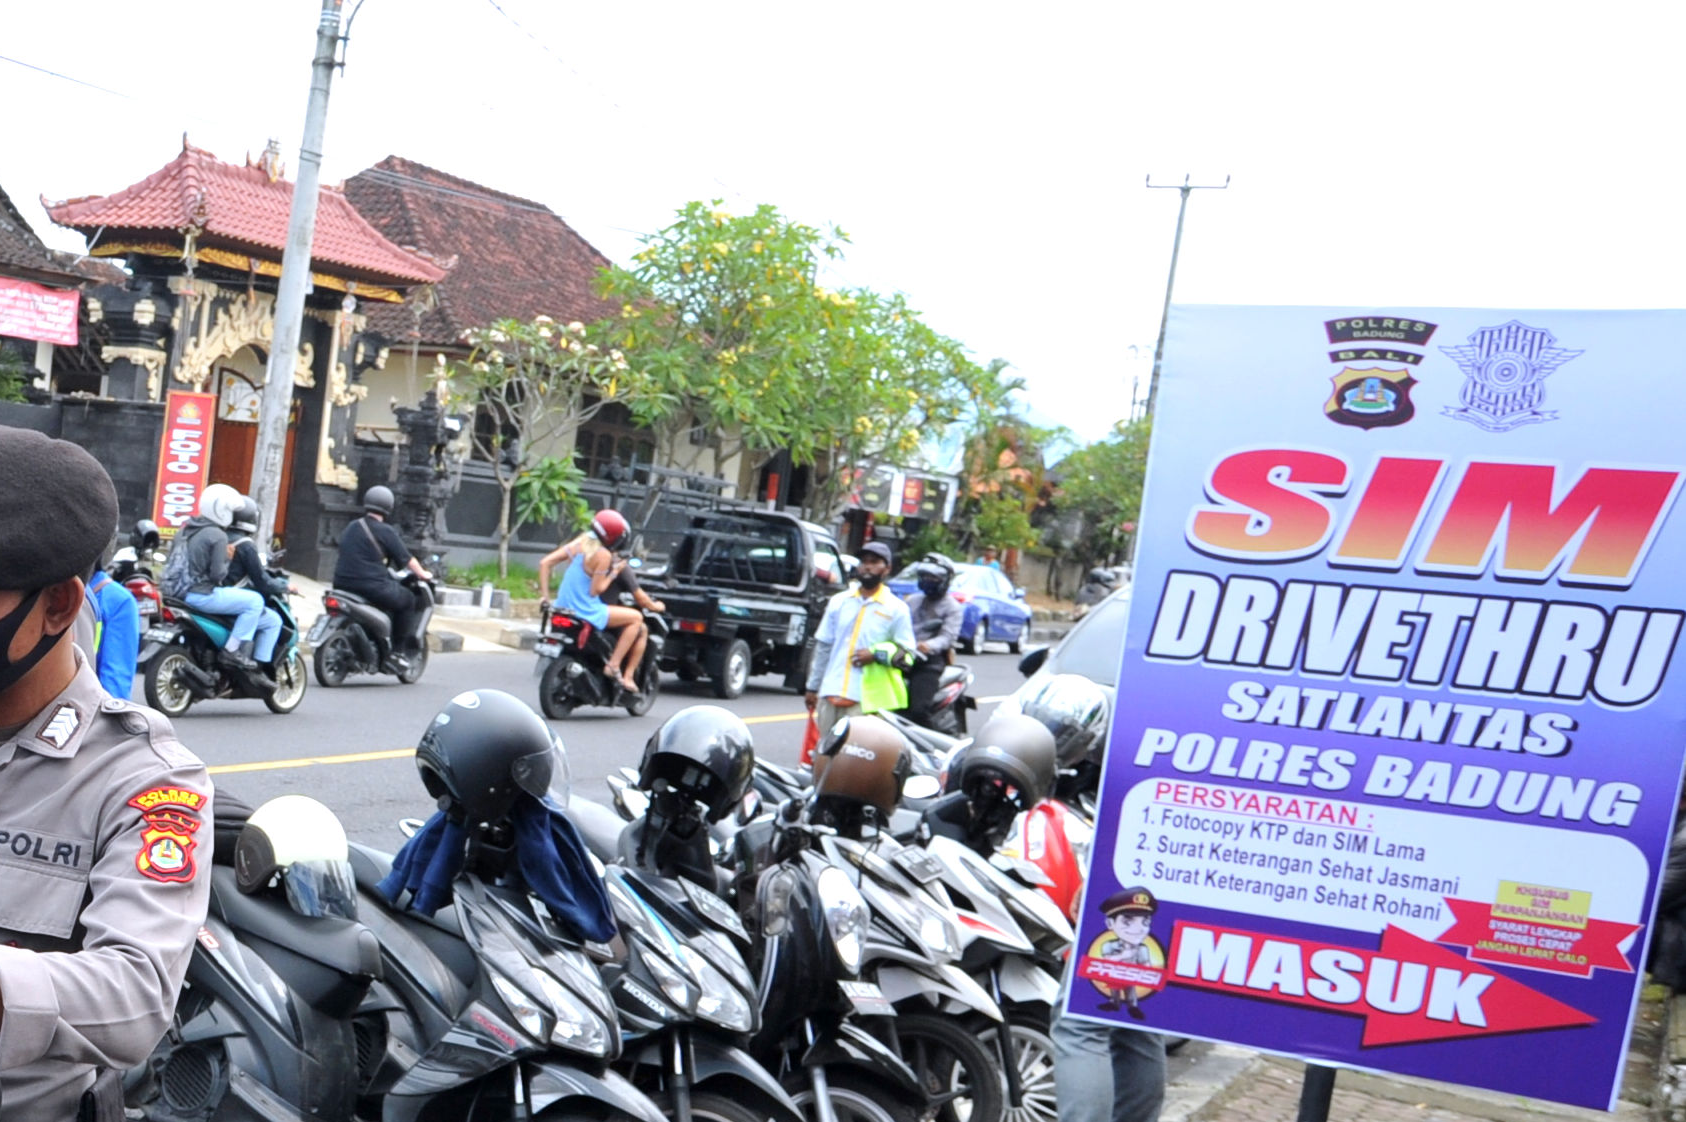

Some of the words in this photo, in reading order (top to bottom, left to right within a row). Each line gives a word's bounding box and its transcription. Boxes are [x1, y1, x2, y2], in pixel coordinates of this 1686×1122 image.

[1335, 318, 1427, 332] POLRES
[1352, 330, 1406, 340] BADUNG
[1338, 350, 1415, 363] BALI
[166, 428, 203, 474] FOTO
[162, 482, 195, 526] COPY
[1187, 446, 1684, 586] SIM
[1145, 569, 1685, 706] DRIVETHRU
[1222, 680, 1576, 757] SATLANTAS
[1134, 728, 1355, 790] POLRES
[1363, 754, 1642, 827] BADUNG
[1155, 781, 1358, 826] PERSYARATAN
[1142, 805, 1155, 825] 1.
[1161, 808, 1245, 841] Fotocopy
[1250, 820, 1289, 842] KTP
[1293, 827, 1327, 848] dan
[1333, 831, 1368, 854] SIM
[1374, 837, 1426, 862] Lama
[1136, 832, 1151, 852] 2.
[1156, 835, 1204, 859] Surat
[1209, 842, 1313, 876] Keterangan
[1319, 858, 1373, 884] Sehat
[1377, 867, 1461, 896] Jasmani
[1132, 858, 1147, 878] 3.
[1152, 862, 1200, 886] Surat
[1204, 868, 1308, 902] Keterangan
[1314, 885, 1368, 911] Sehat
[1372, 893, 1442, 922] Rohani
[1476, 940, 1519, 955] JANGAN
[1519, 945, 1556, 960] LEWAT
[1556, 951, 1588, 966] CALO
[1489, 919, 1530, 934] SYARAT
[1530, 926, 1583, 942] LENGKAP
[1494, 931, 1537, 947] PROSES
[1537, 938, 1574, 952] CEPAT
[1086, 961, 1163, 985] PRESISI
[1174, 927, 1497, 1028] MASUK
[622, 981, 667, 1018] HONDA
